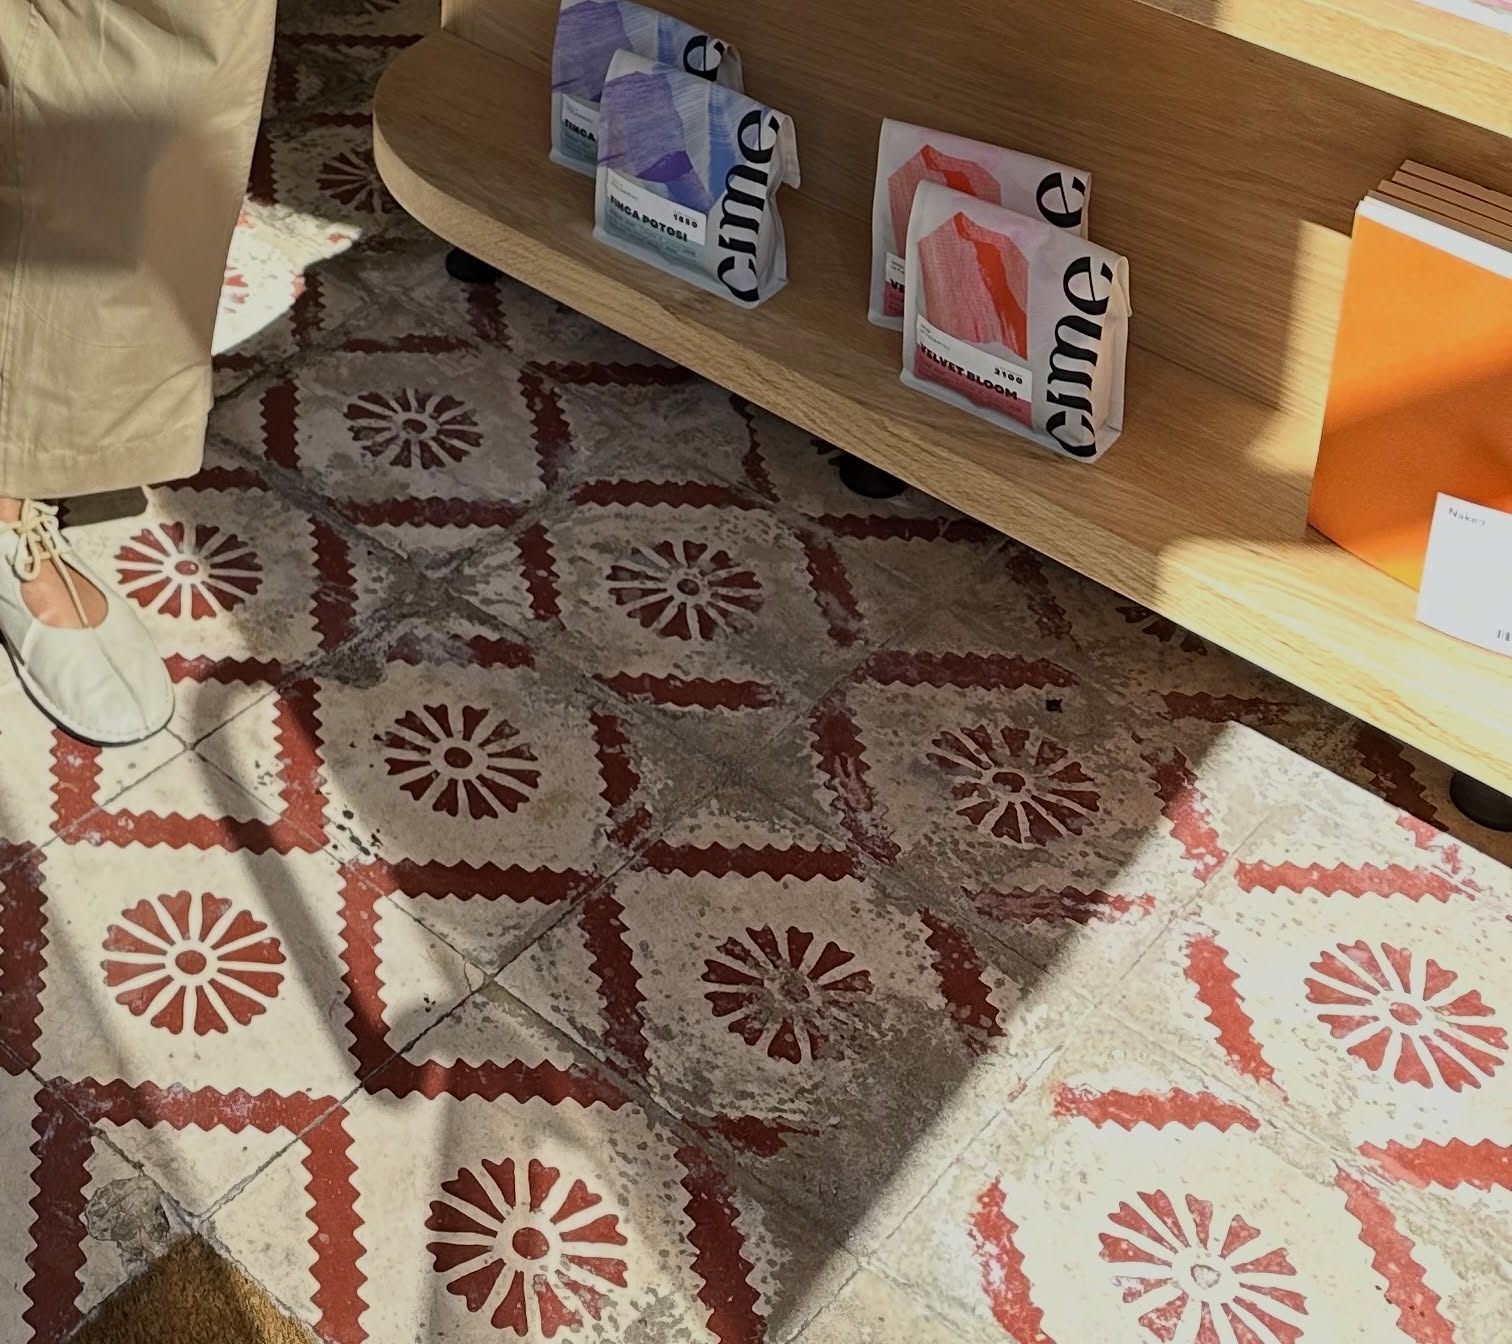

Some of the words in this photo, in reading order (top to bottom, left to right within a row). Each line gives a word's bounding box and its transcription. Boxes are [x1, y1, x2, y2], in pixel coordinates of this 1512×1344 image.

[610, 195, 640, 220] FINCA
[642, 214, 687, 242] POTOSI
[717, 110, 780, 302] cime
[920, 342, 964, 376] VELVET
[966, 371, 1018, 400] BLOOM
[994, 367, 1023, 385] 2100
[1046, 256, 1113, 457] cime
